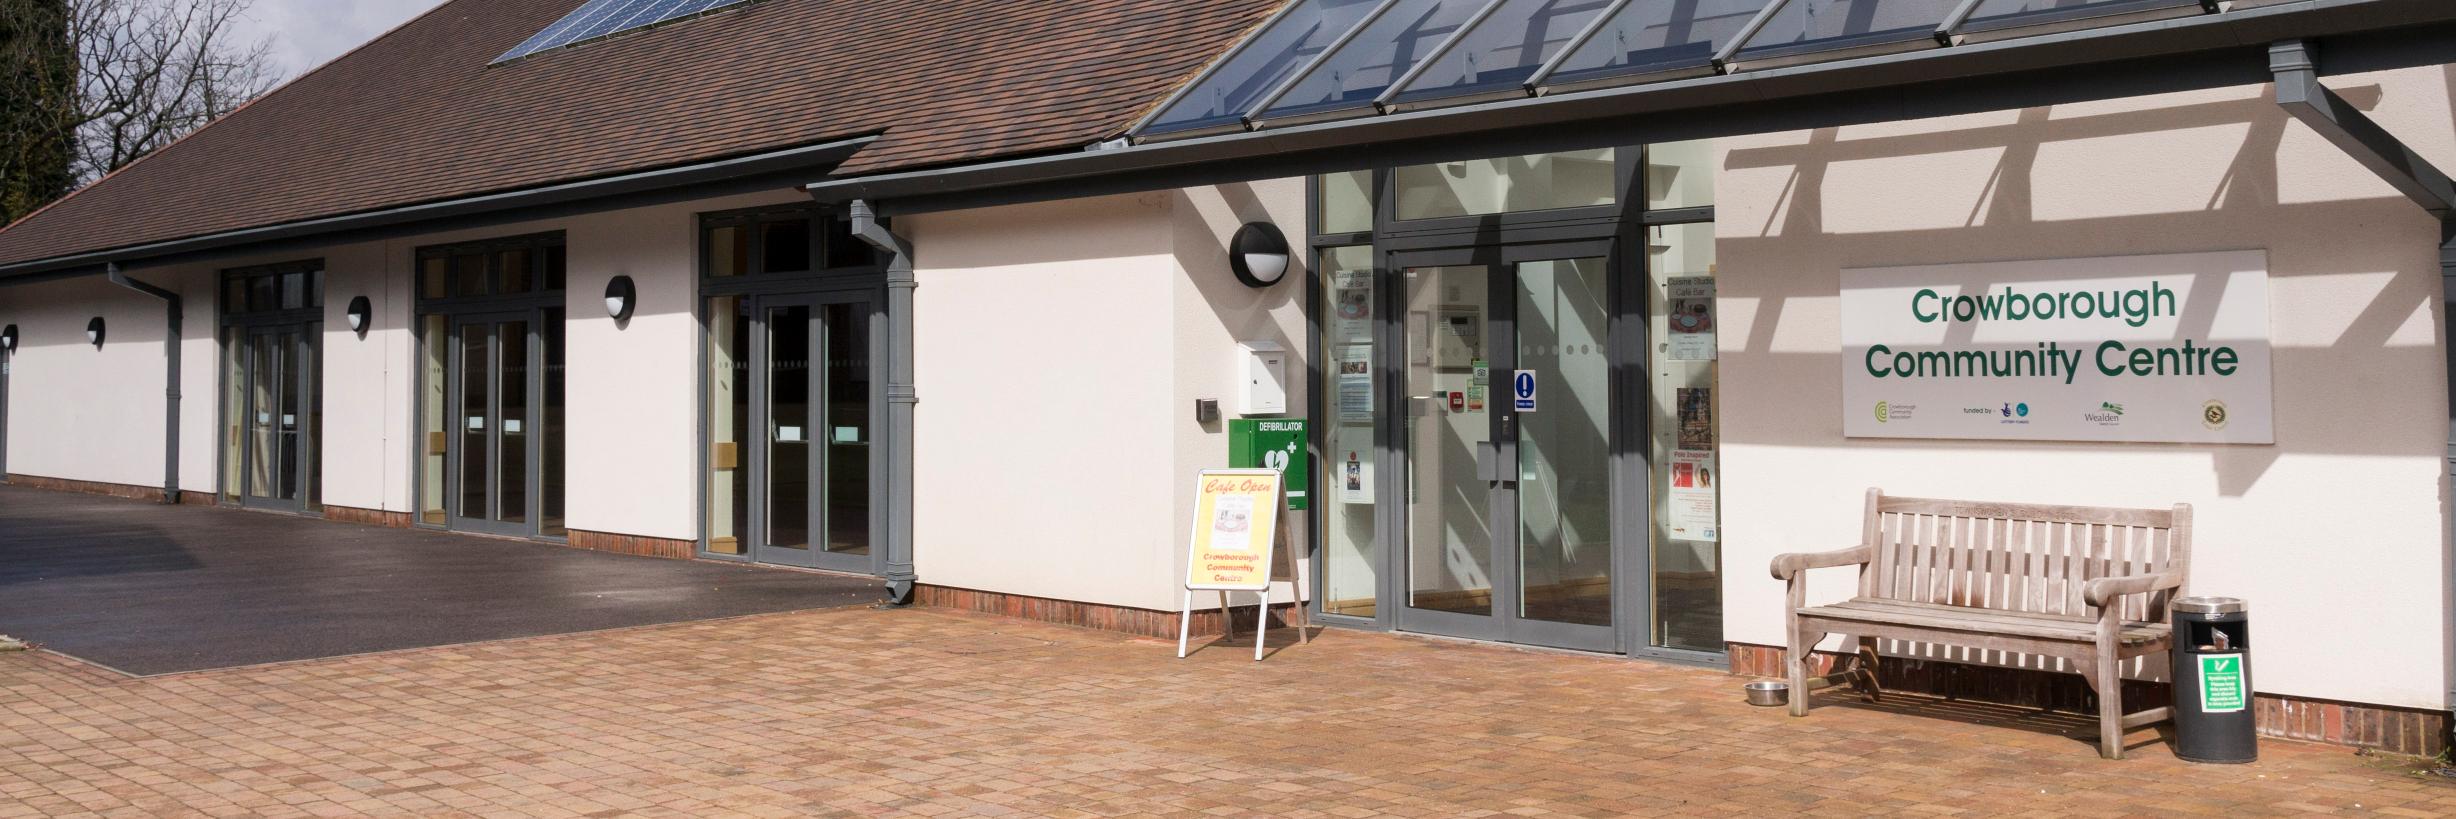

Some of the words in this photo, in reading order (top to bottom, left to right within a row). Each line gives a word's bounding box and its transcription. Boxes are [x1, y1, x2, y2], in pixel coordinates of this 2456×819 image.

[1911, 280, 2176, 328] Crowborough
[1865, 341, 2083, 385] Community
[2095, 339, 2239, 377] Centre
[1985, 407, 1992, 415] by
[2084, 413, 2119, 422] Wealden
[1259, 421, 1303, 432] DEFIBRILLATOR
[1240, 478, 1272, 495] Open
[1203, 552, 1260, 562] Crowborough
[1207, 563, 1255, 573] Community
[1214, 574, 1243, 582] Centre
